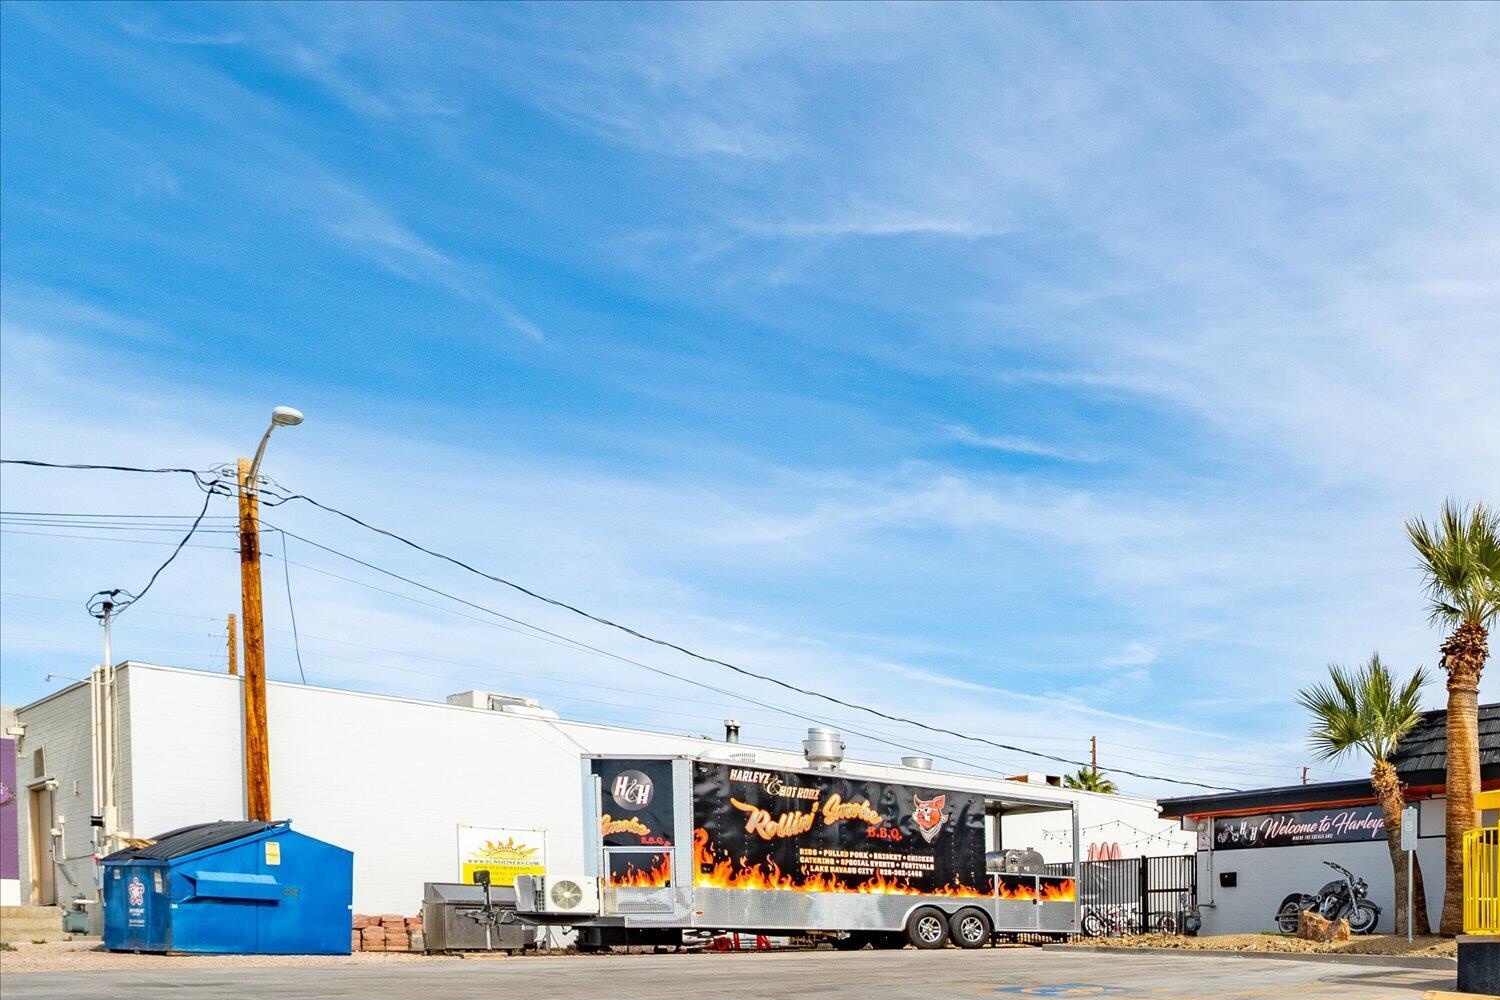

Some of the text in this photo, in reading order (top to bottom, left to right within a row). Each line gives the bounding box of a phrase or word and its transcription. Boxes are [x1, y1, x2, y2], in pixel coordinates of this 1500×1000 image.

[729, 768, 771, 784] HARLEYZ
[779, 785, 821, 800] HOT RODZ
[822, 793, 883, 825] Smoke
[1260, 815, 1318, 840] Welcome
[1318, 815, 1332, 833] to
[799, 848, 934, 863] RIBS PULLED PORK BRISKET CHICKEN
[799, 856, 935, 871] CATERING SPECIAL EVENTS FESTIVALS
[810, 865, 829, 873] LAKE
[858, 867, 874, 875] CITY
